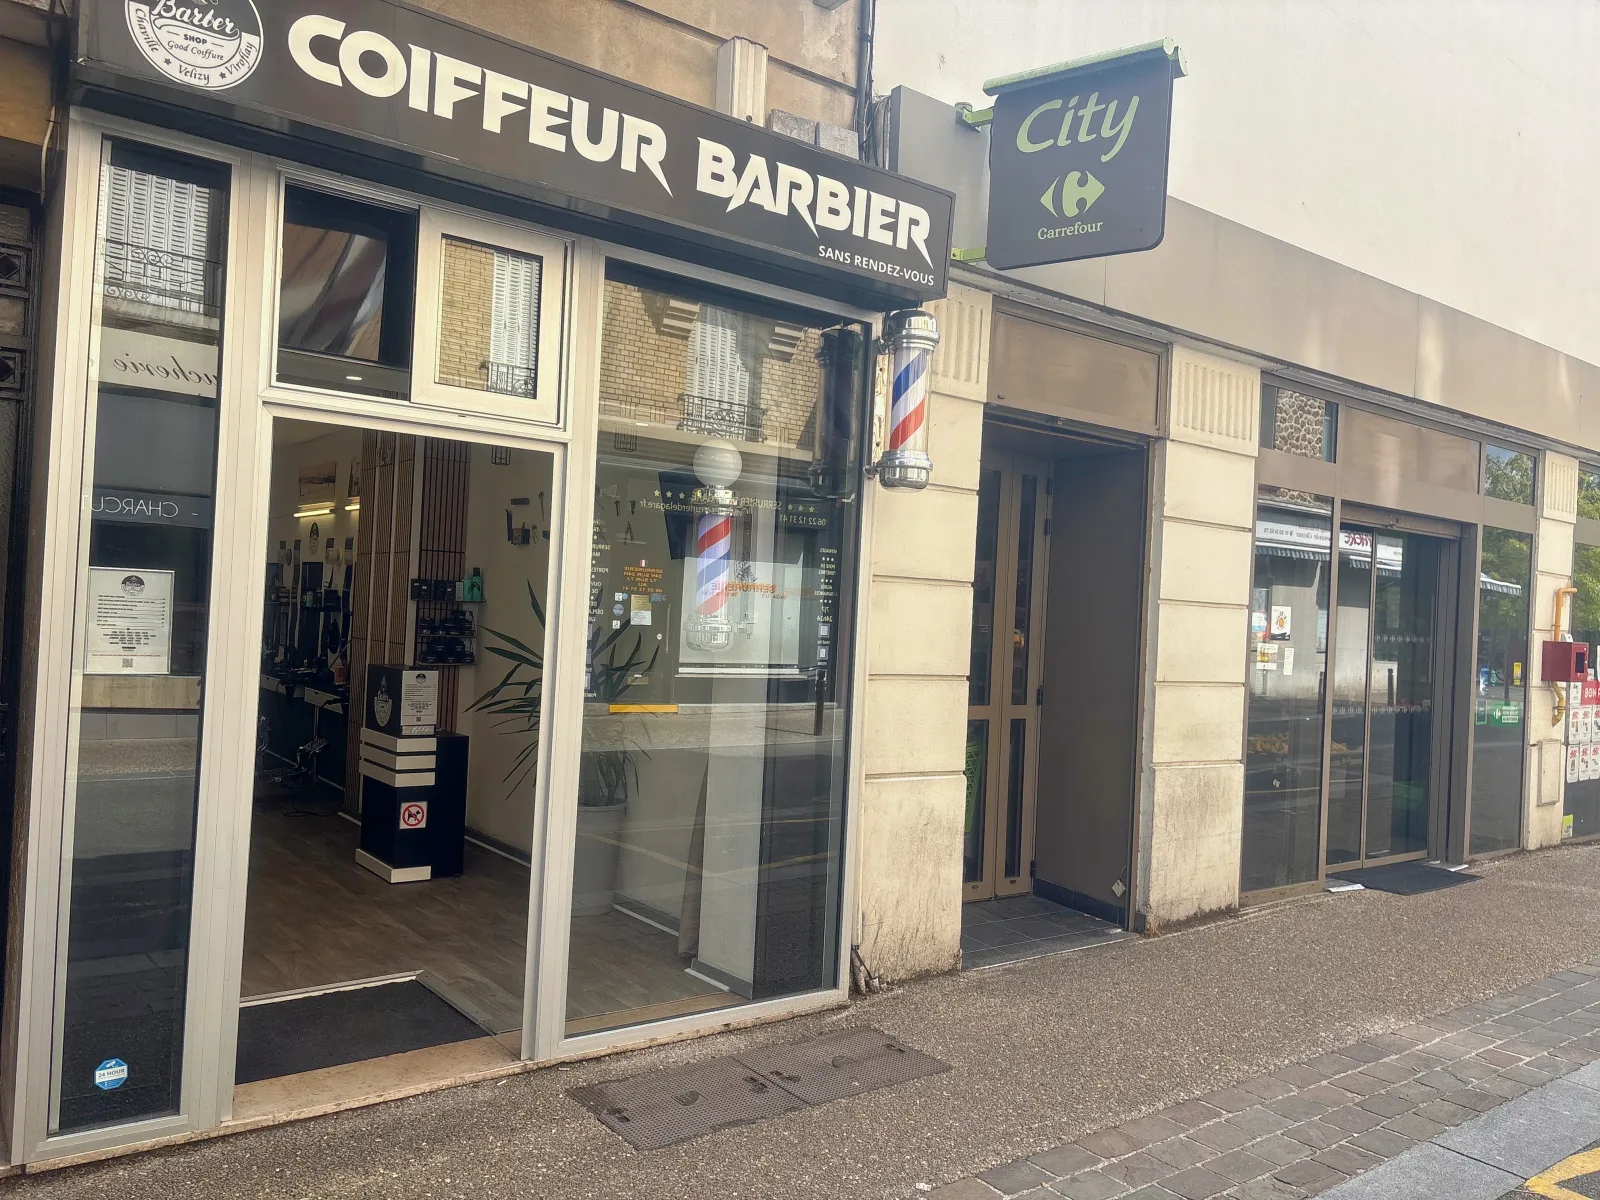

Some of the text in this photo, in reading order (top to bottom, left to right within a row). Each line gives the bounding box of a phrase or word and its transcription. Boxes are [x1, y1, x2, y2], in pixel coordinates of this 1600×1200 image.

[135, 8, 160, 53] Chaville
[151, 0, 239, 34] Barber
[167, 41, 224, 61] Good Coiffure
[184, 34, 208, 45] SHOP
[178, 64, 210, 85] Velizy
[225, 42, 257, 75] Viroflay
[288, 15, 933, 269] COIFFEUR BARBIER
[1016, 92, 1139, 162] City
[1037, 221, 1104, 240] Carrefour
[818, 246, 934, 287] SANS RENDEZ-VOUS
[106, 1068, 125, 1076] HOUR
